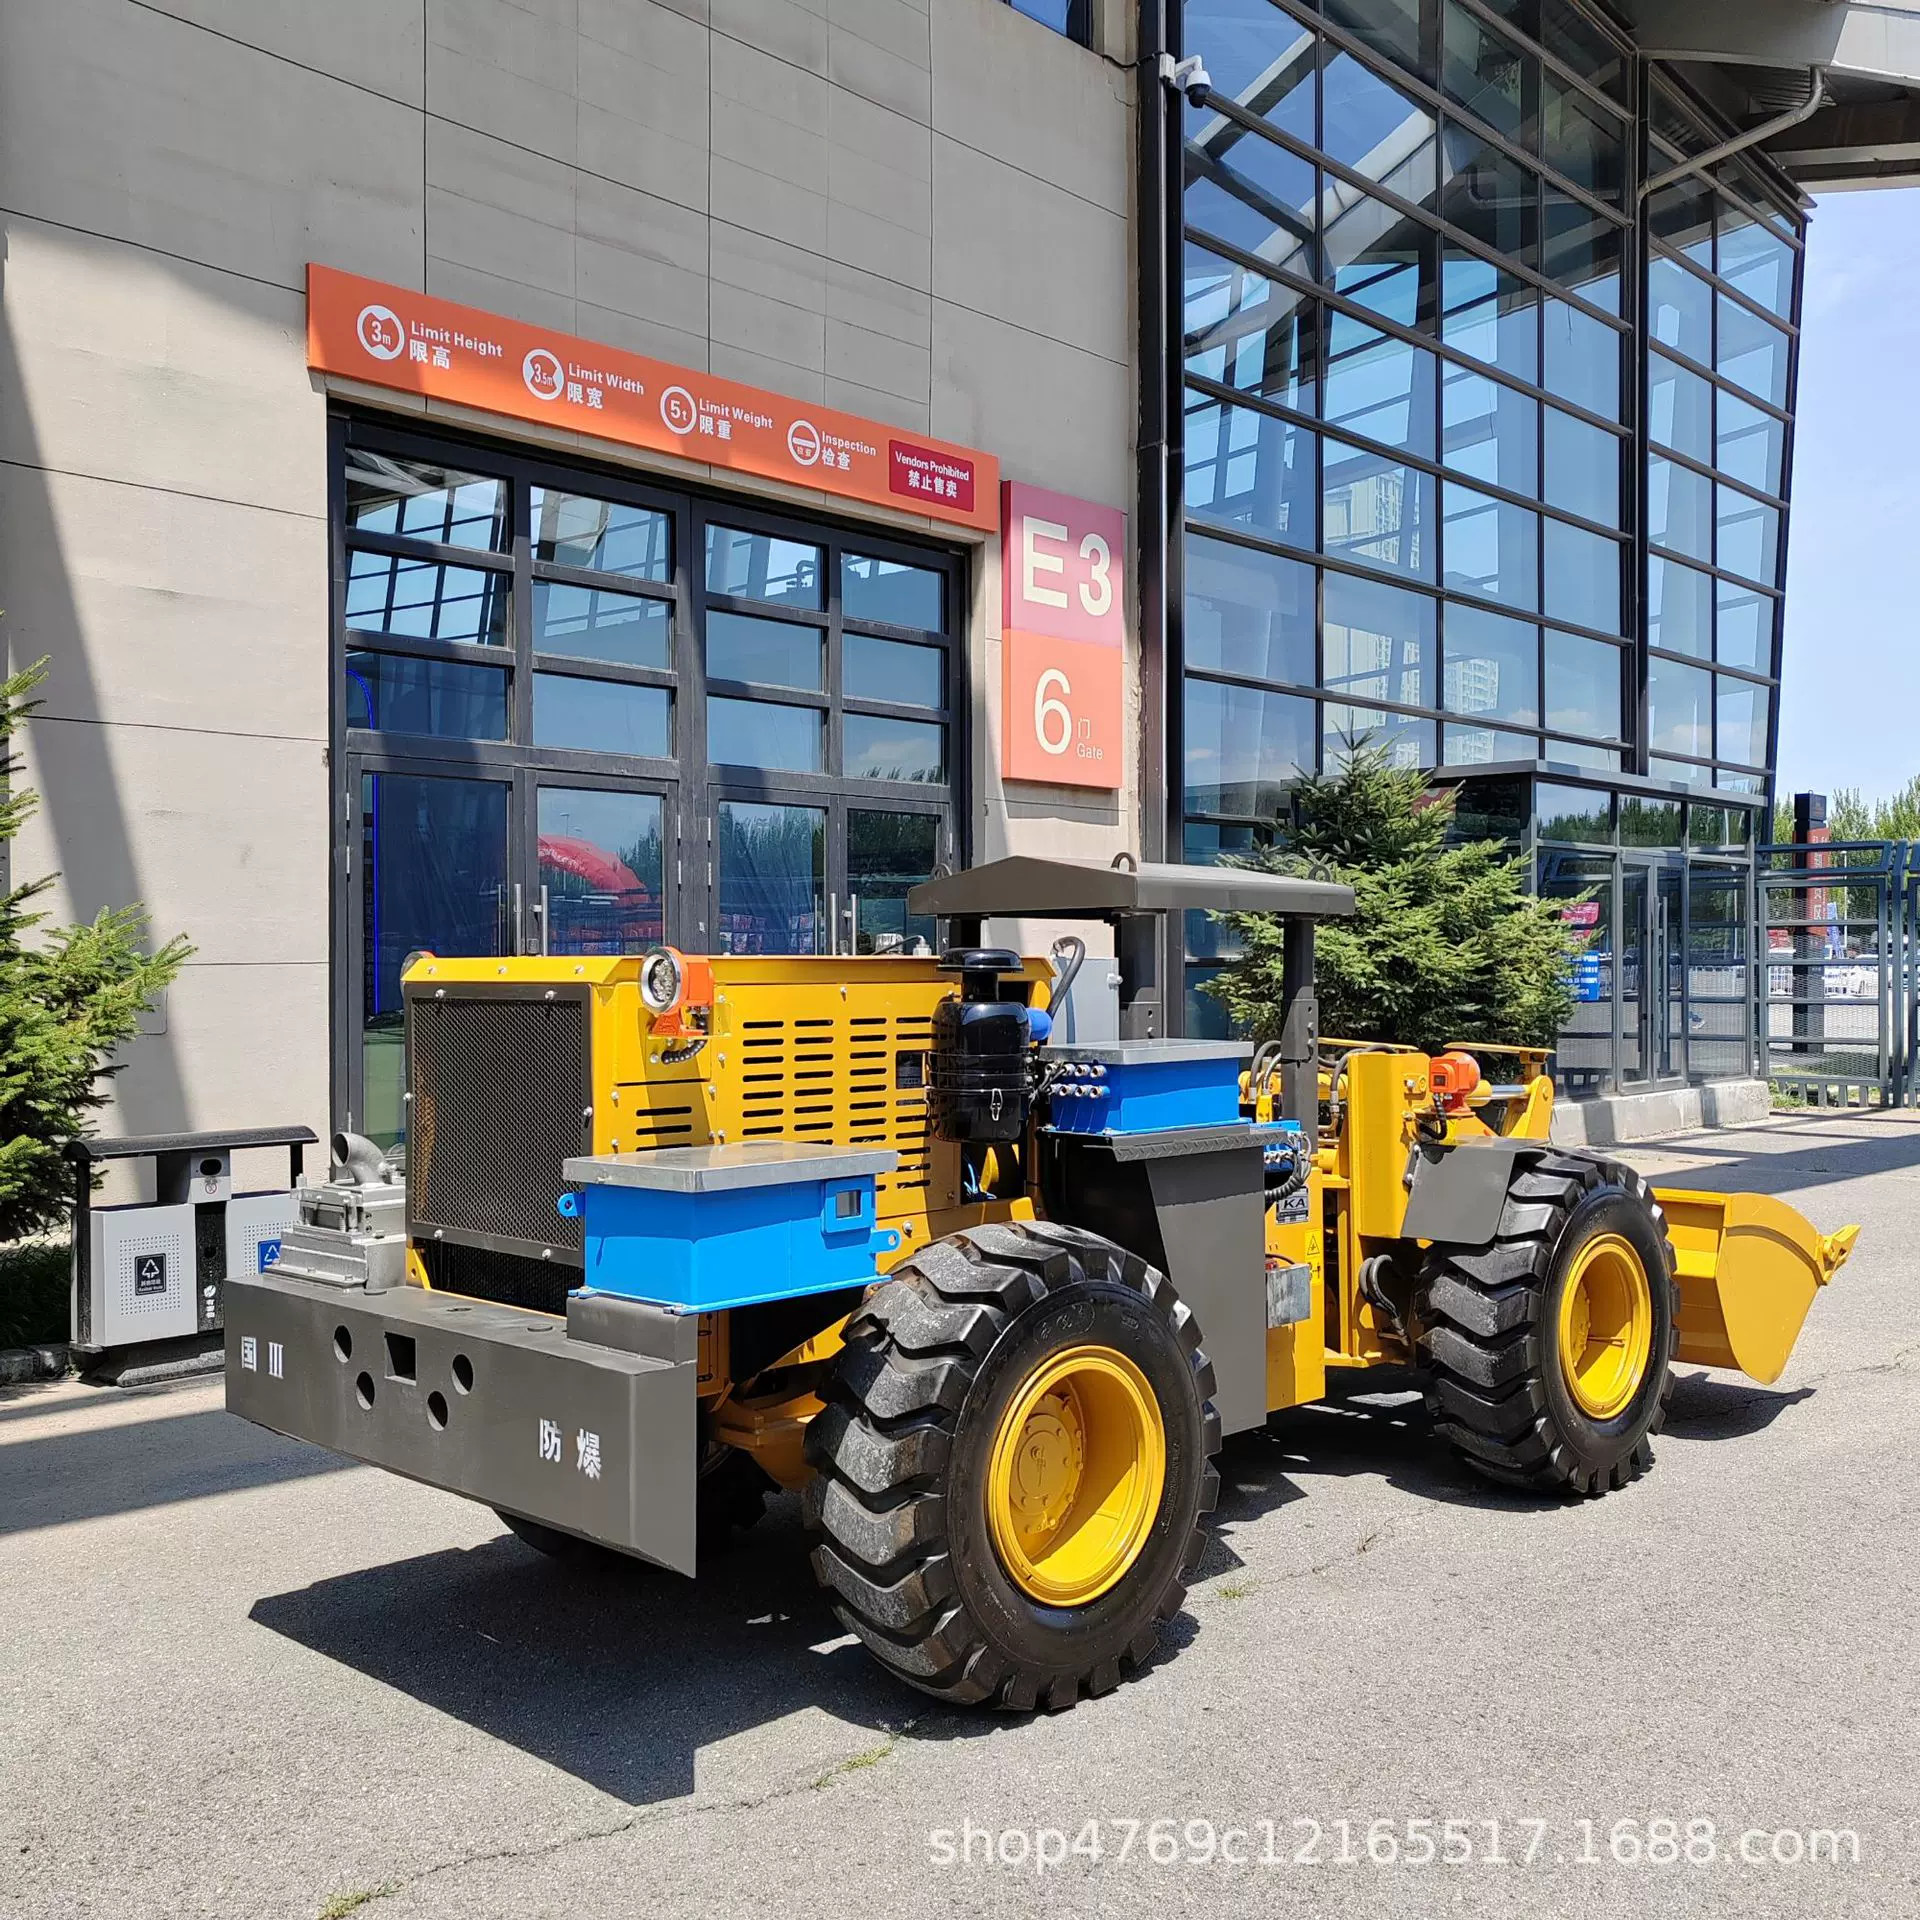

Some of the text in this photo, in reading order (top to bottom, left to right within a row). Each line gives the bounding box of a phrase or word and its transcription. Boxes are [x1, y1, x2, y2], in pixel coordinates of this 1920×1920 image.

[371, 320, 391, 346] 3m
[411, 320, 503, 358] Limit Height
[409, 339, 451, 370] 限高
[568, 362, 644, 396] Limit Width
[567, 382, 603, 410] 限宽
[670, 400, 688, 422] 5t
[699, 398, 773, 430] Limit Weight
[699, 415, 732, 440] 限重
[821, 447, 851, 471] 检查
[822, 431, 877, 457] Inspection
[895, 451, 970, 482] Vendors Prohibited
[908, 469, 958, 499] 禁止售卖
[1023, 515, 1113, 617] E3
[1034, 668, 1073, 755] 6
[1076, 742, 1104, 760] Gate
[539, 1418, 602, 1481] 防爆
